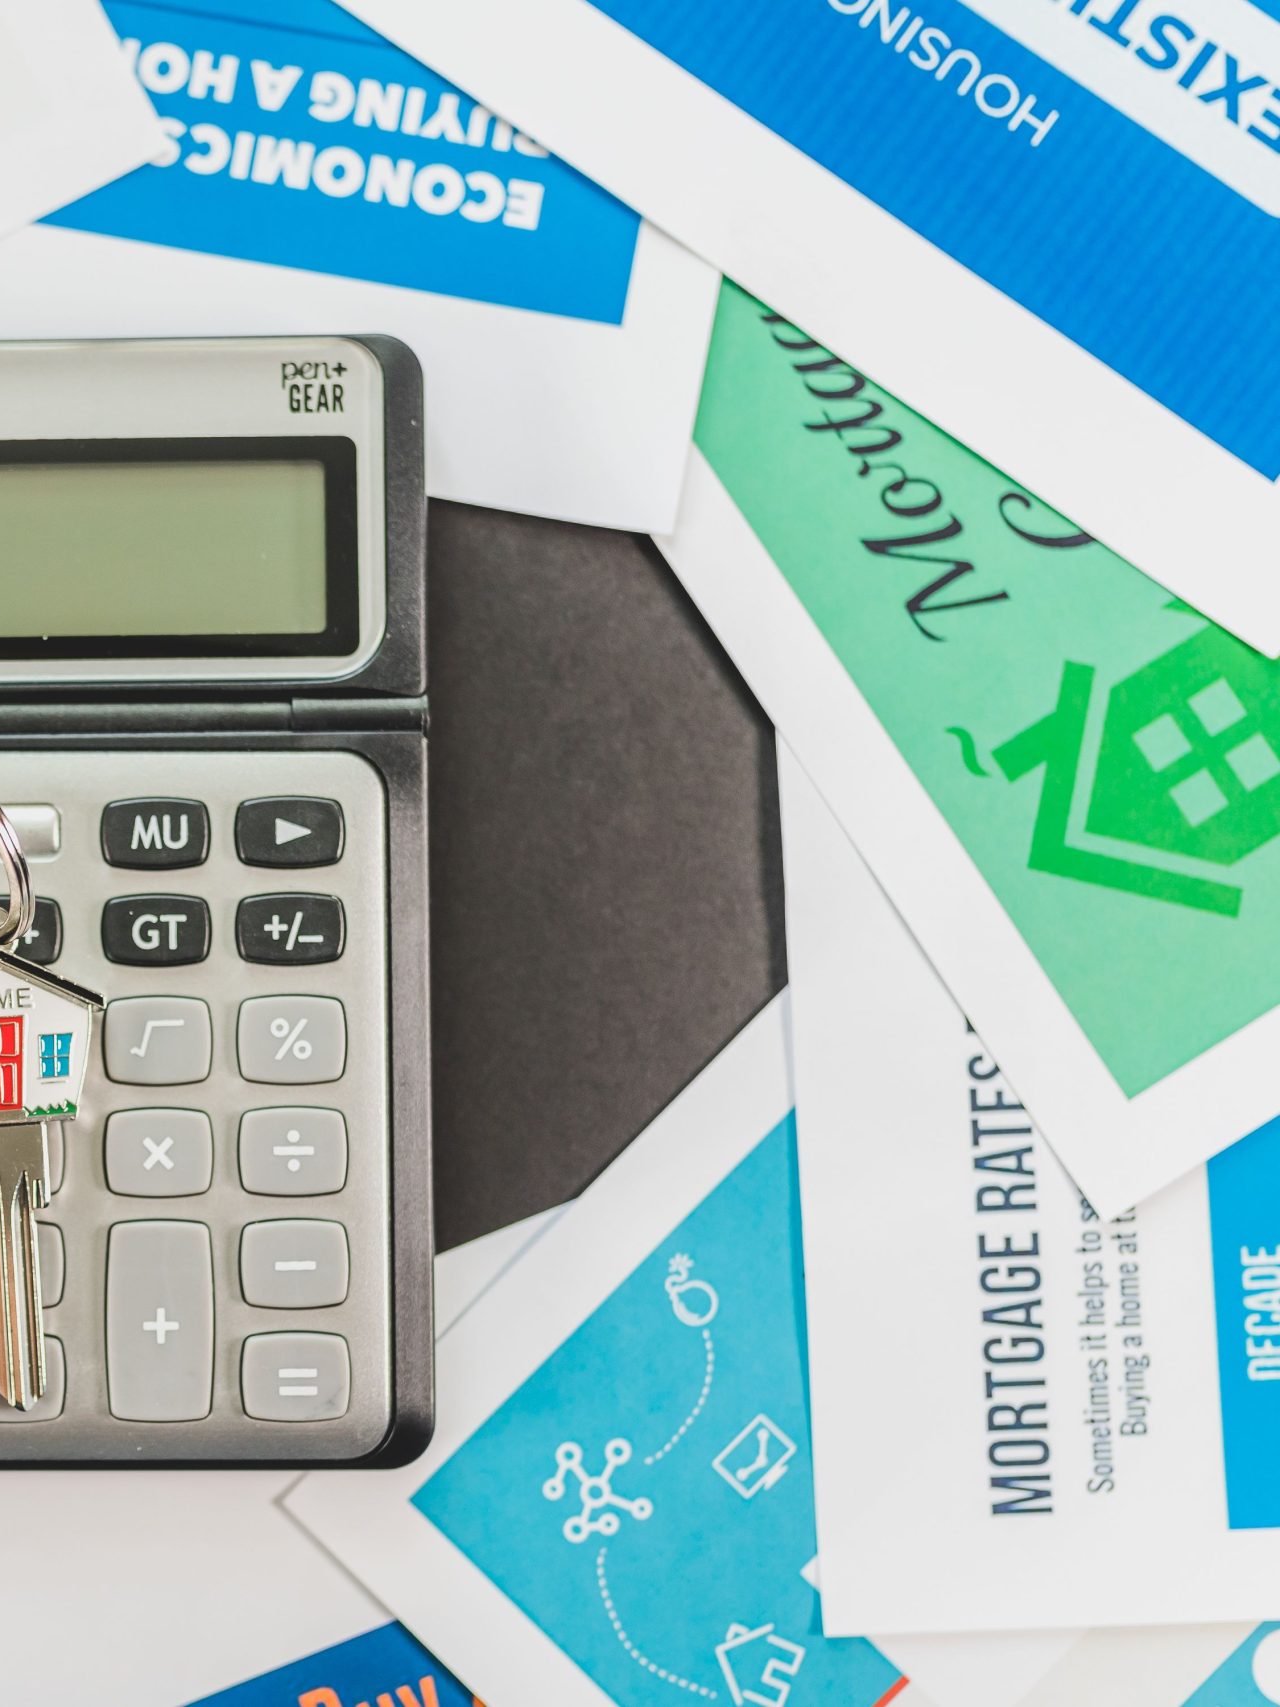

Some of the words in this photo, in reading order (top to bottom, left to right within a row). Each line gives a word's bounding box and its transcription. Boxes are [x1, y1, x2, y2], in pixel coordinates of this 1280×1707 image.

[122, 37, 240, 104] HO
[250, 59, 303, 112] A
[828, 0, 1060, 147] HOUSIN
[1048, 0, 1280, 155] XIST
[308, 71, 552, 159] UYING
[148, 116, 545, 231] ECONOMICS
[289, 383, 344, 413] GEAR
[130, 814, 188, 850] MU
[131, 914, 187, 950] GT
[270, 1017, 312, 1060] %
[1075, 1231, 1102, 1254] to
[1110, 1233, 1137, 1254] at
[1077, 1261, 1110, 1327] helps
[1115, 1262, 1141, 1328] home
[1240, 1245, 1280, 1381] DECADE
[978, 1232, 1053, 1515] MORTGAGE
[1080, 1333, 1106, 1351] it
[1123, 1335, 1142, 1348] a
[1084, 1357, 1114, 1494] Sometimes
[1118, 1354, 1151, 1436] Buying
